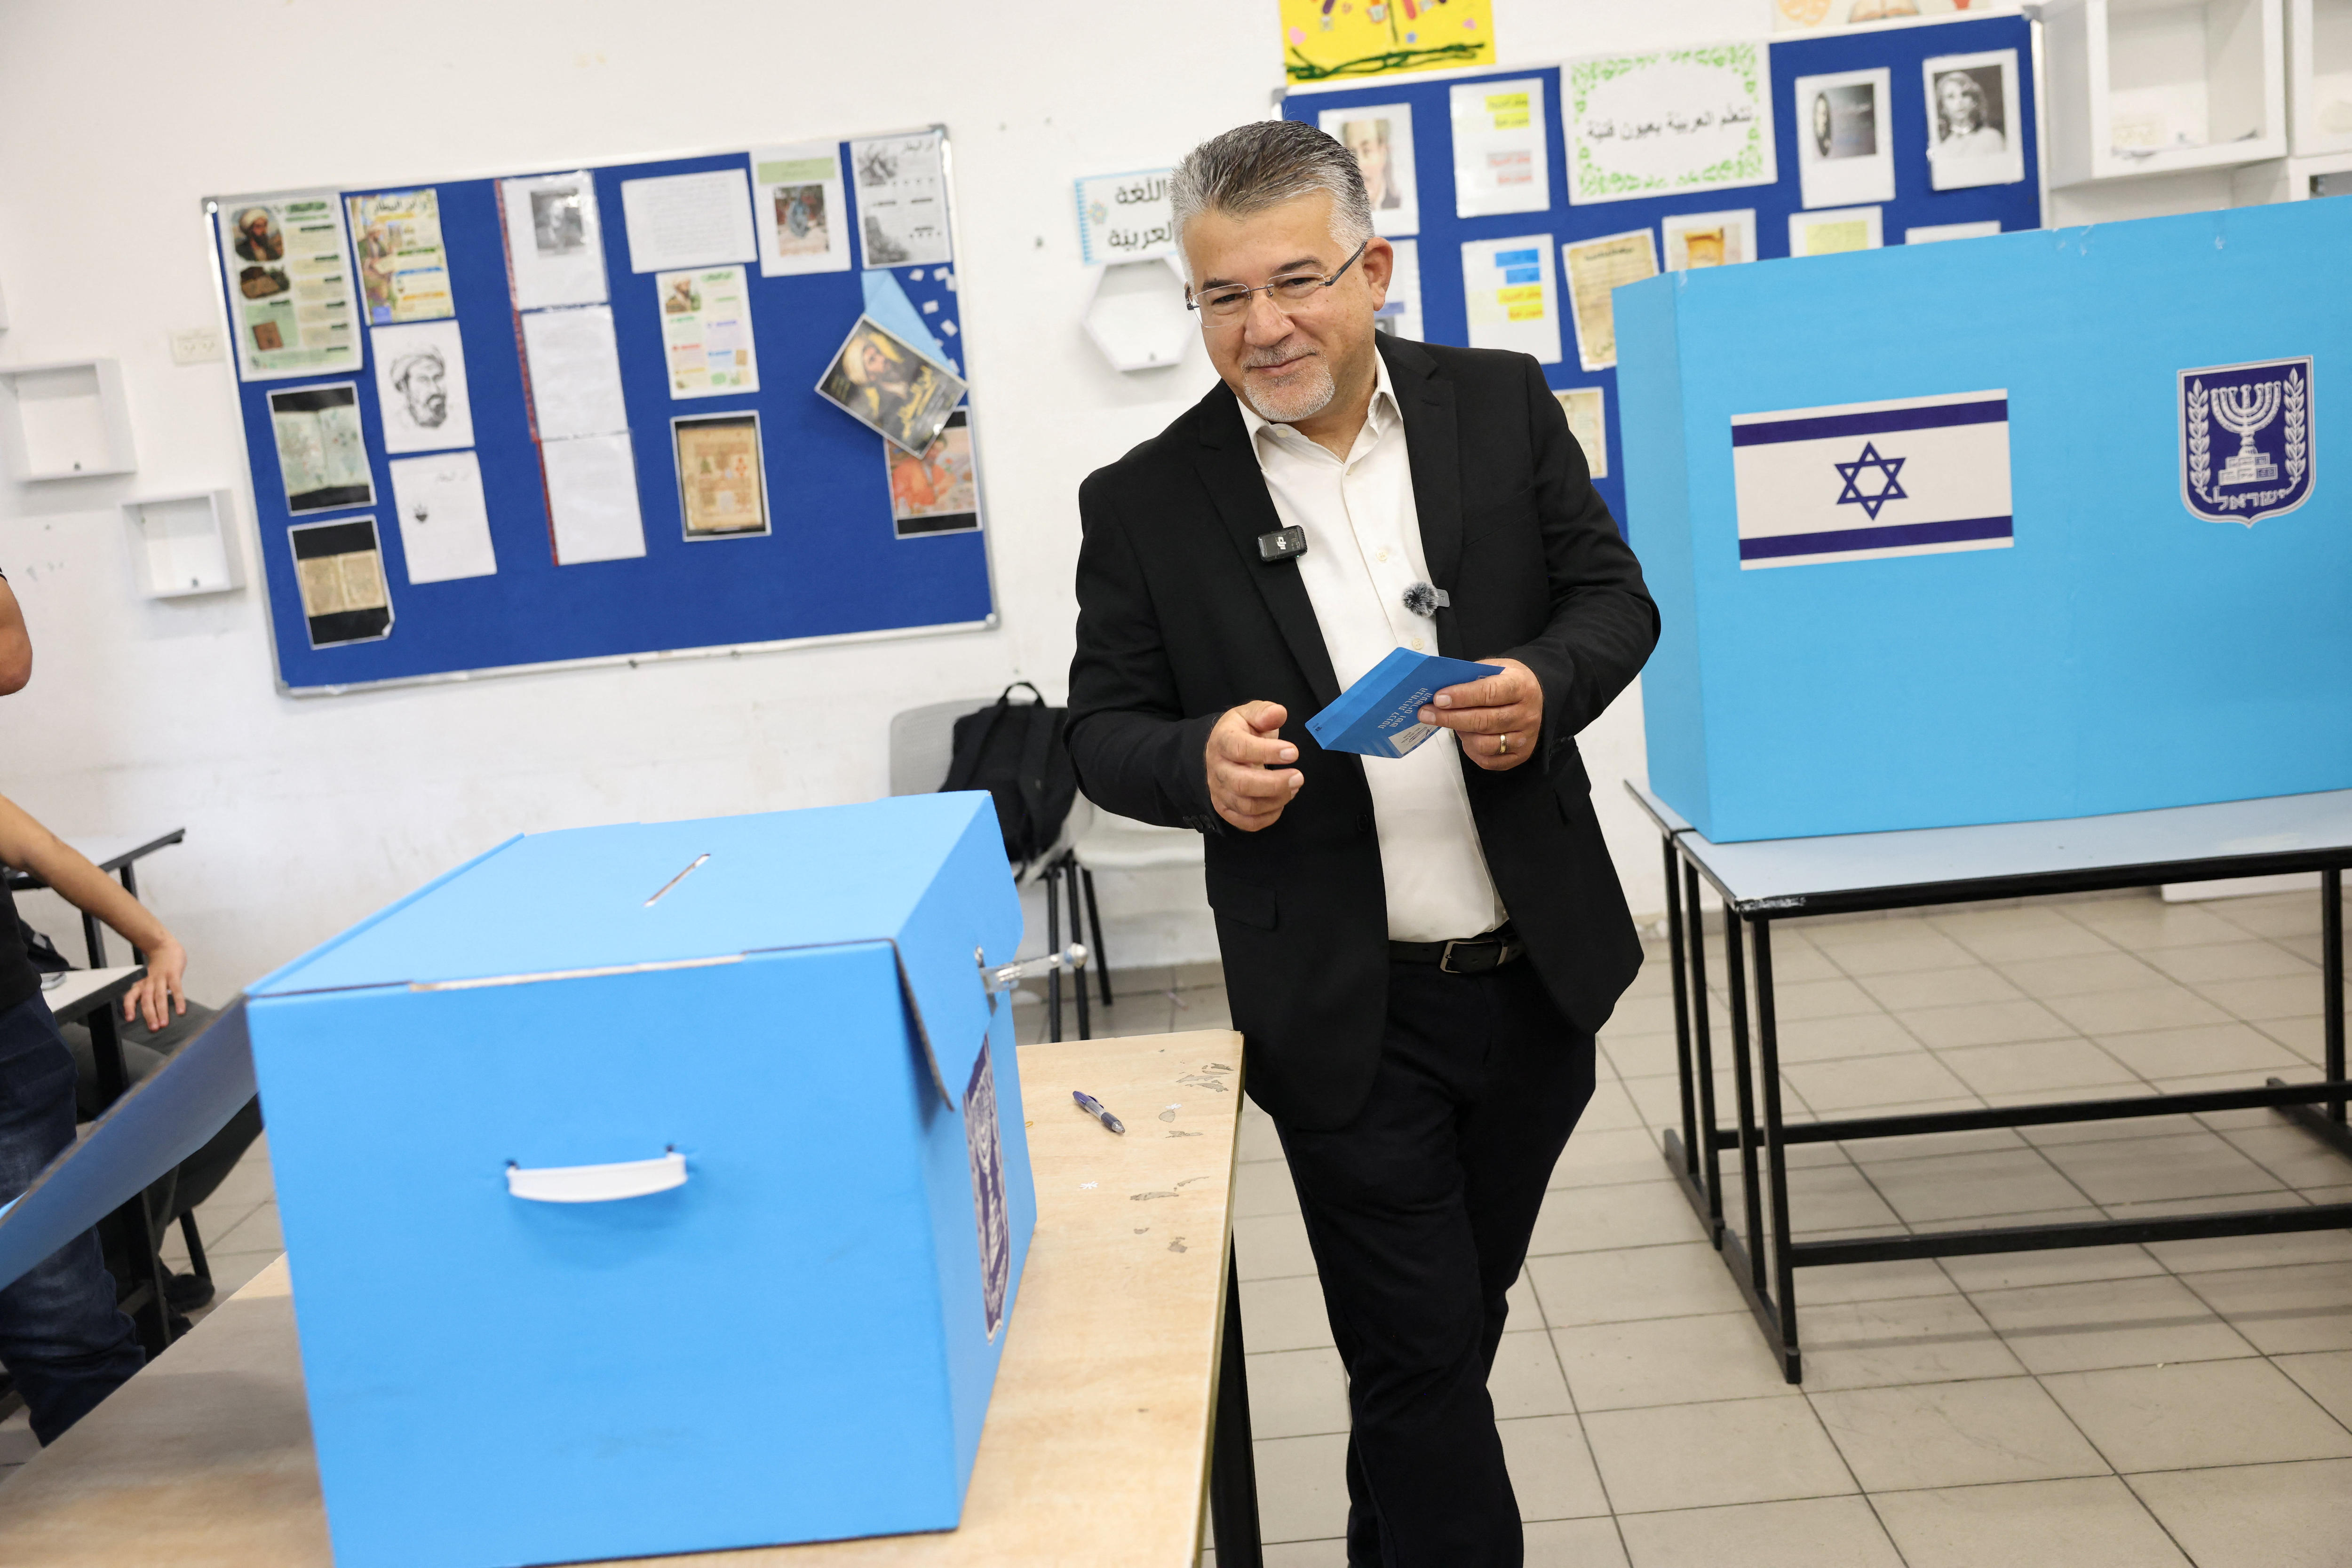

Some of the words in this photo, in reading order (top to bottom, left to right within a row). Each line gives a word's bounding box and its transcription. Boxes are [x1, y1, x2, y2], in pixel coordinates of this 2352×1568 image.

[2212, 486, 2286, 511] ישראל
[1398, 688, 1428, 711] הבחירות
[1404, 693, 1433, 714] העשרים
[1377, 712, 1400, 729] לכנסת
[1389, 715, 1406, 727] ושש
